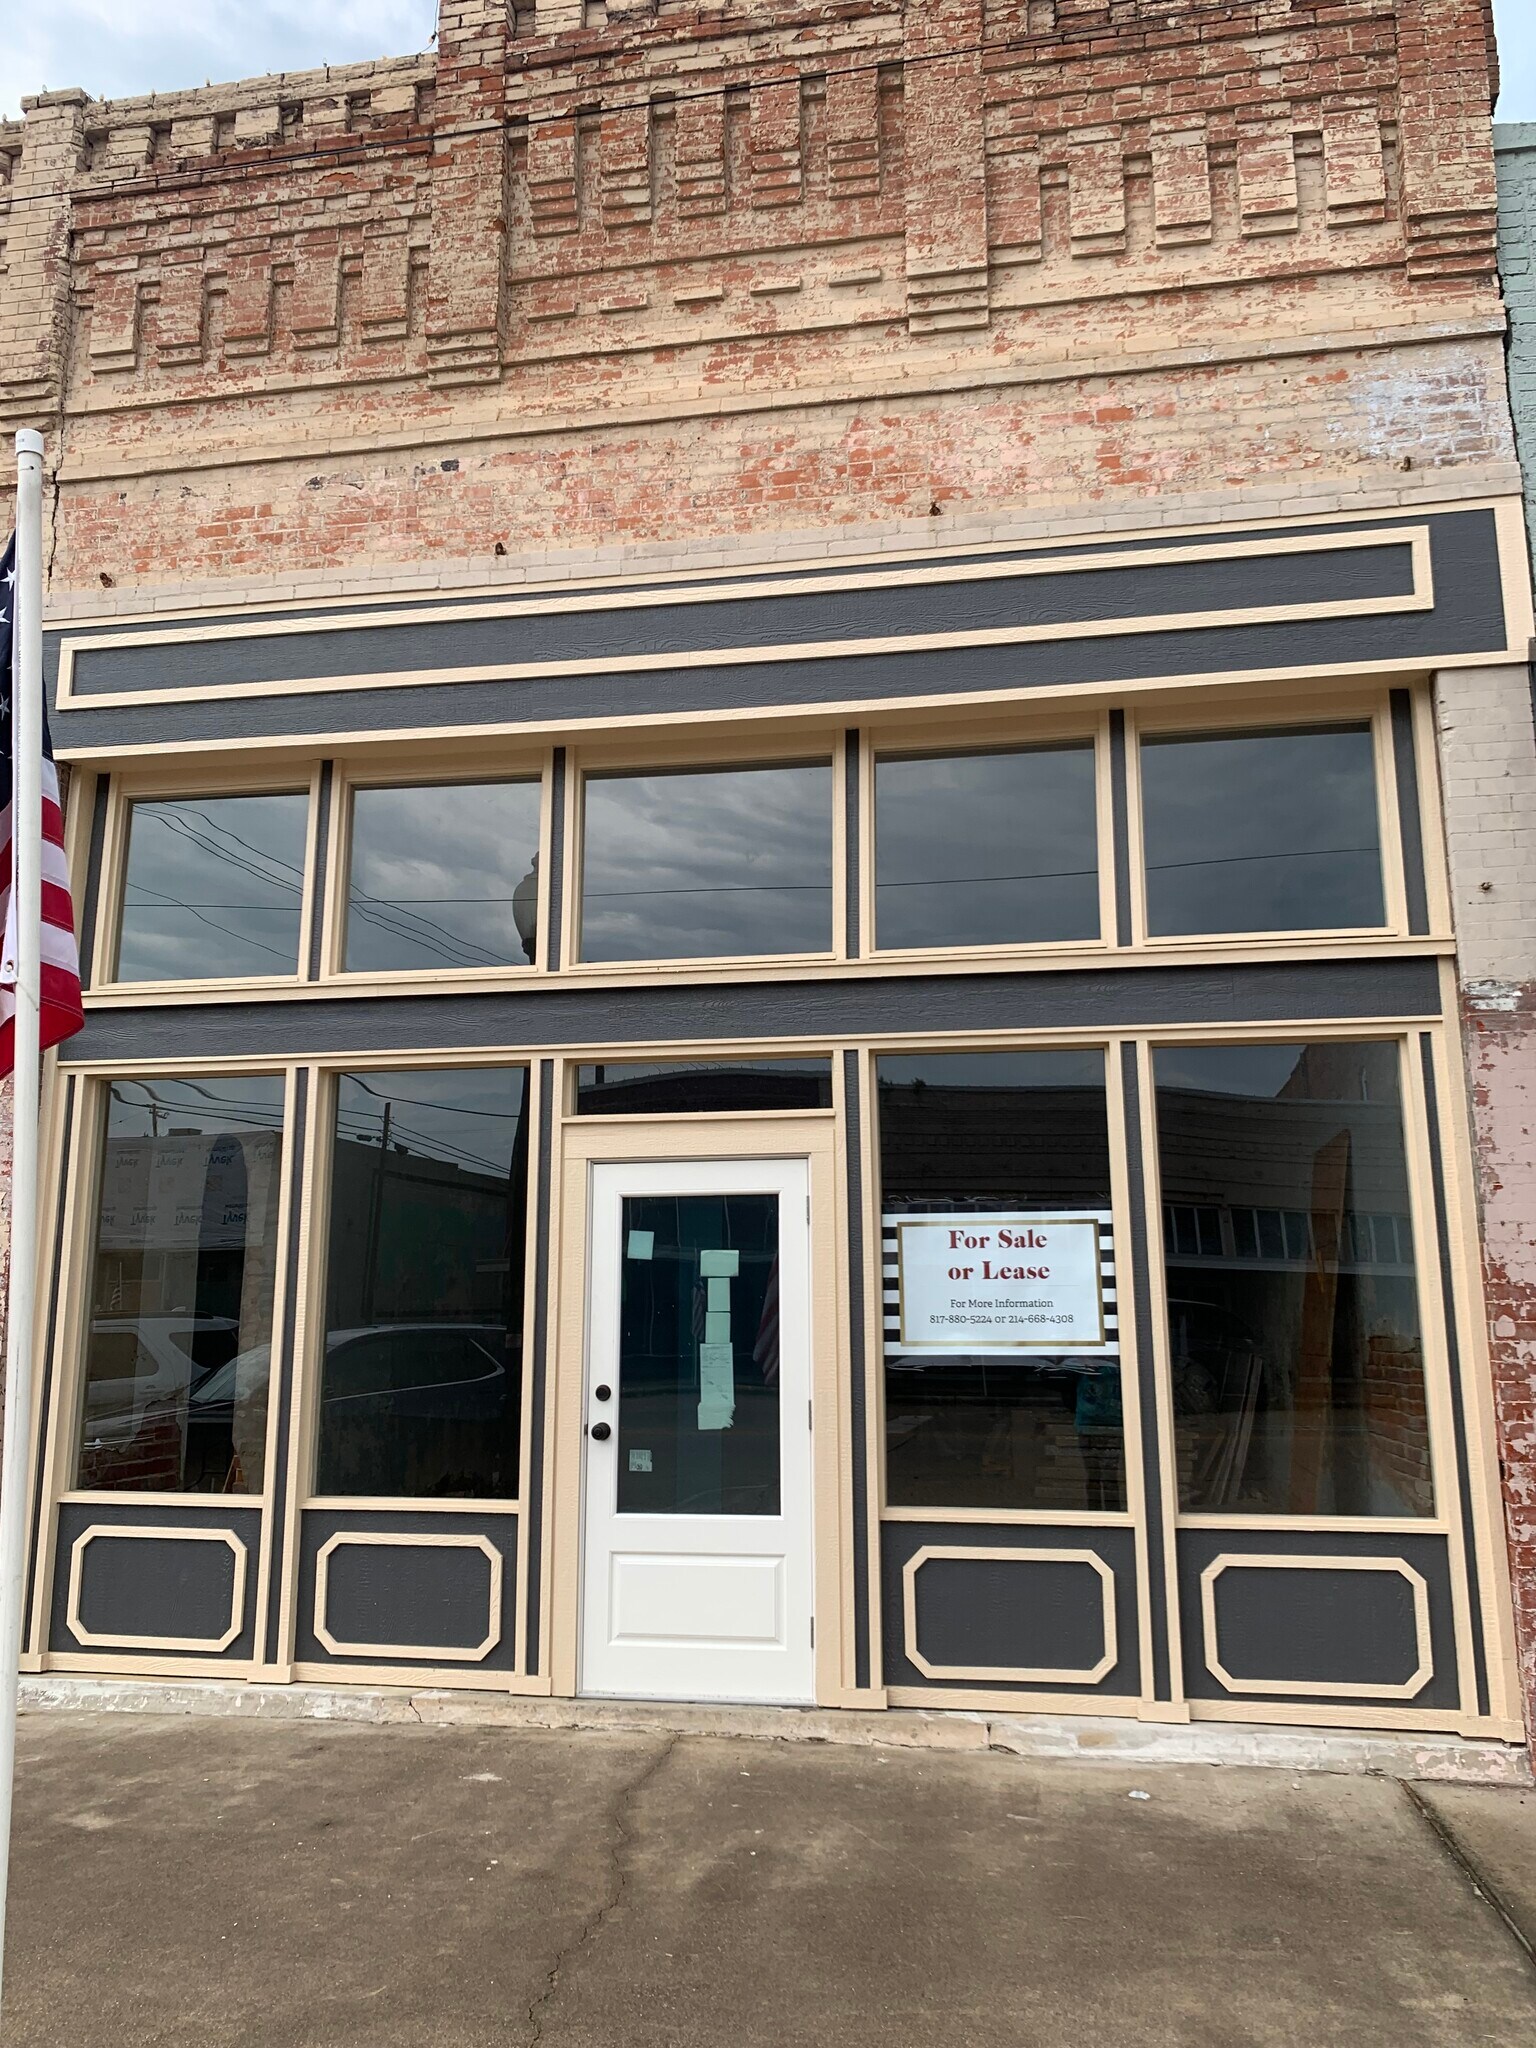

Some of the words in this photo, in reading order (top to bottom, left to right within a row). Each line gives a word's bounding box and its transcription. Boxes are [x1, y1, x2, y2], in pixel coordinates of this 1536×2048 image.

[948, 1230, 990, 1249] For
[998, 1229, 1048, 1249] Sale
[948, 1267, 974, 1280] or
[981, 1260, 1050, 1280] Lease
[950, 1299, 966, 1308] For
[968, 1299, 993, 1308] More
[995, 1298, 1054, 1308] Information
[929, 1314, 992, 1324] 817-880-5224
[995, 1315, 1006, 1324] or
[1008, 1314, 1074, 1324] 214-668-4308
